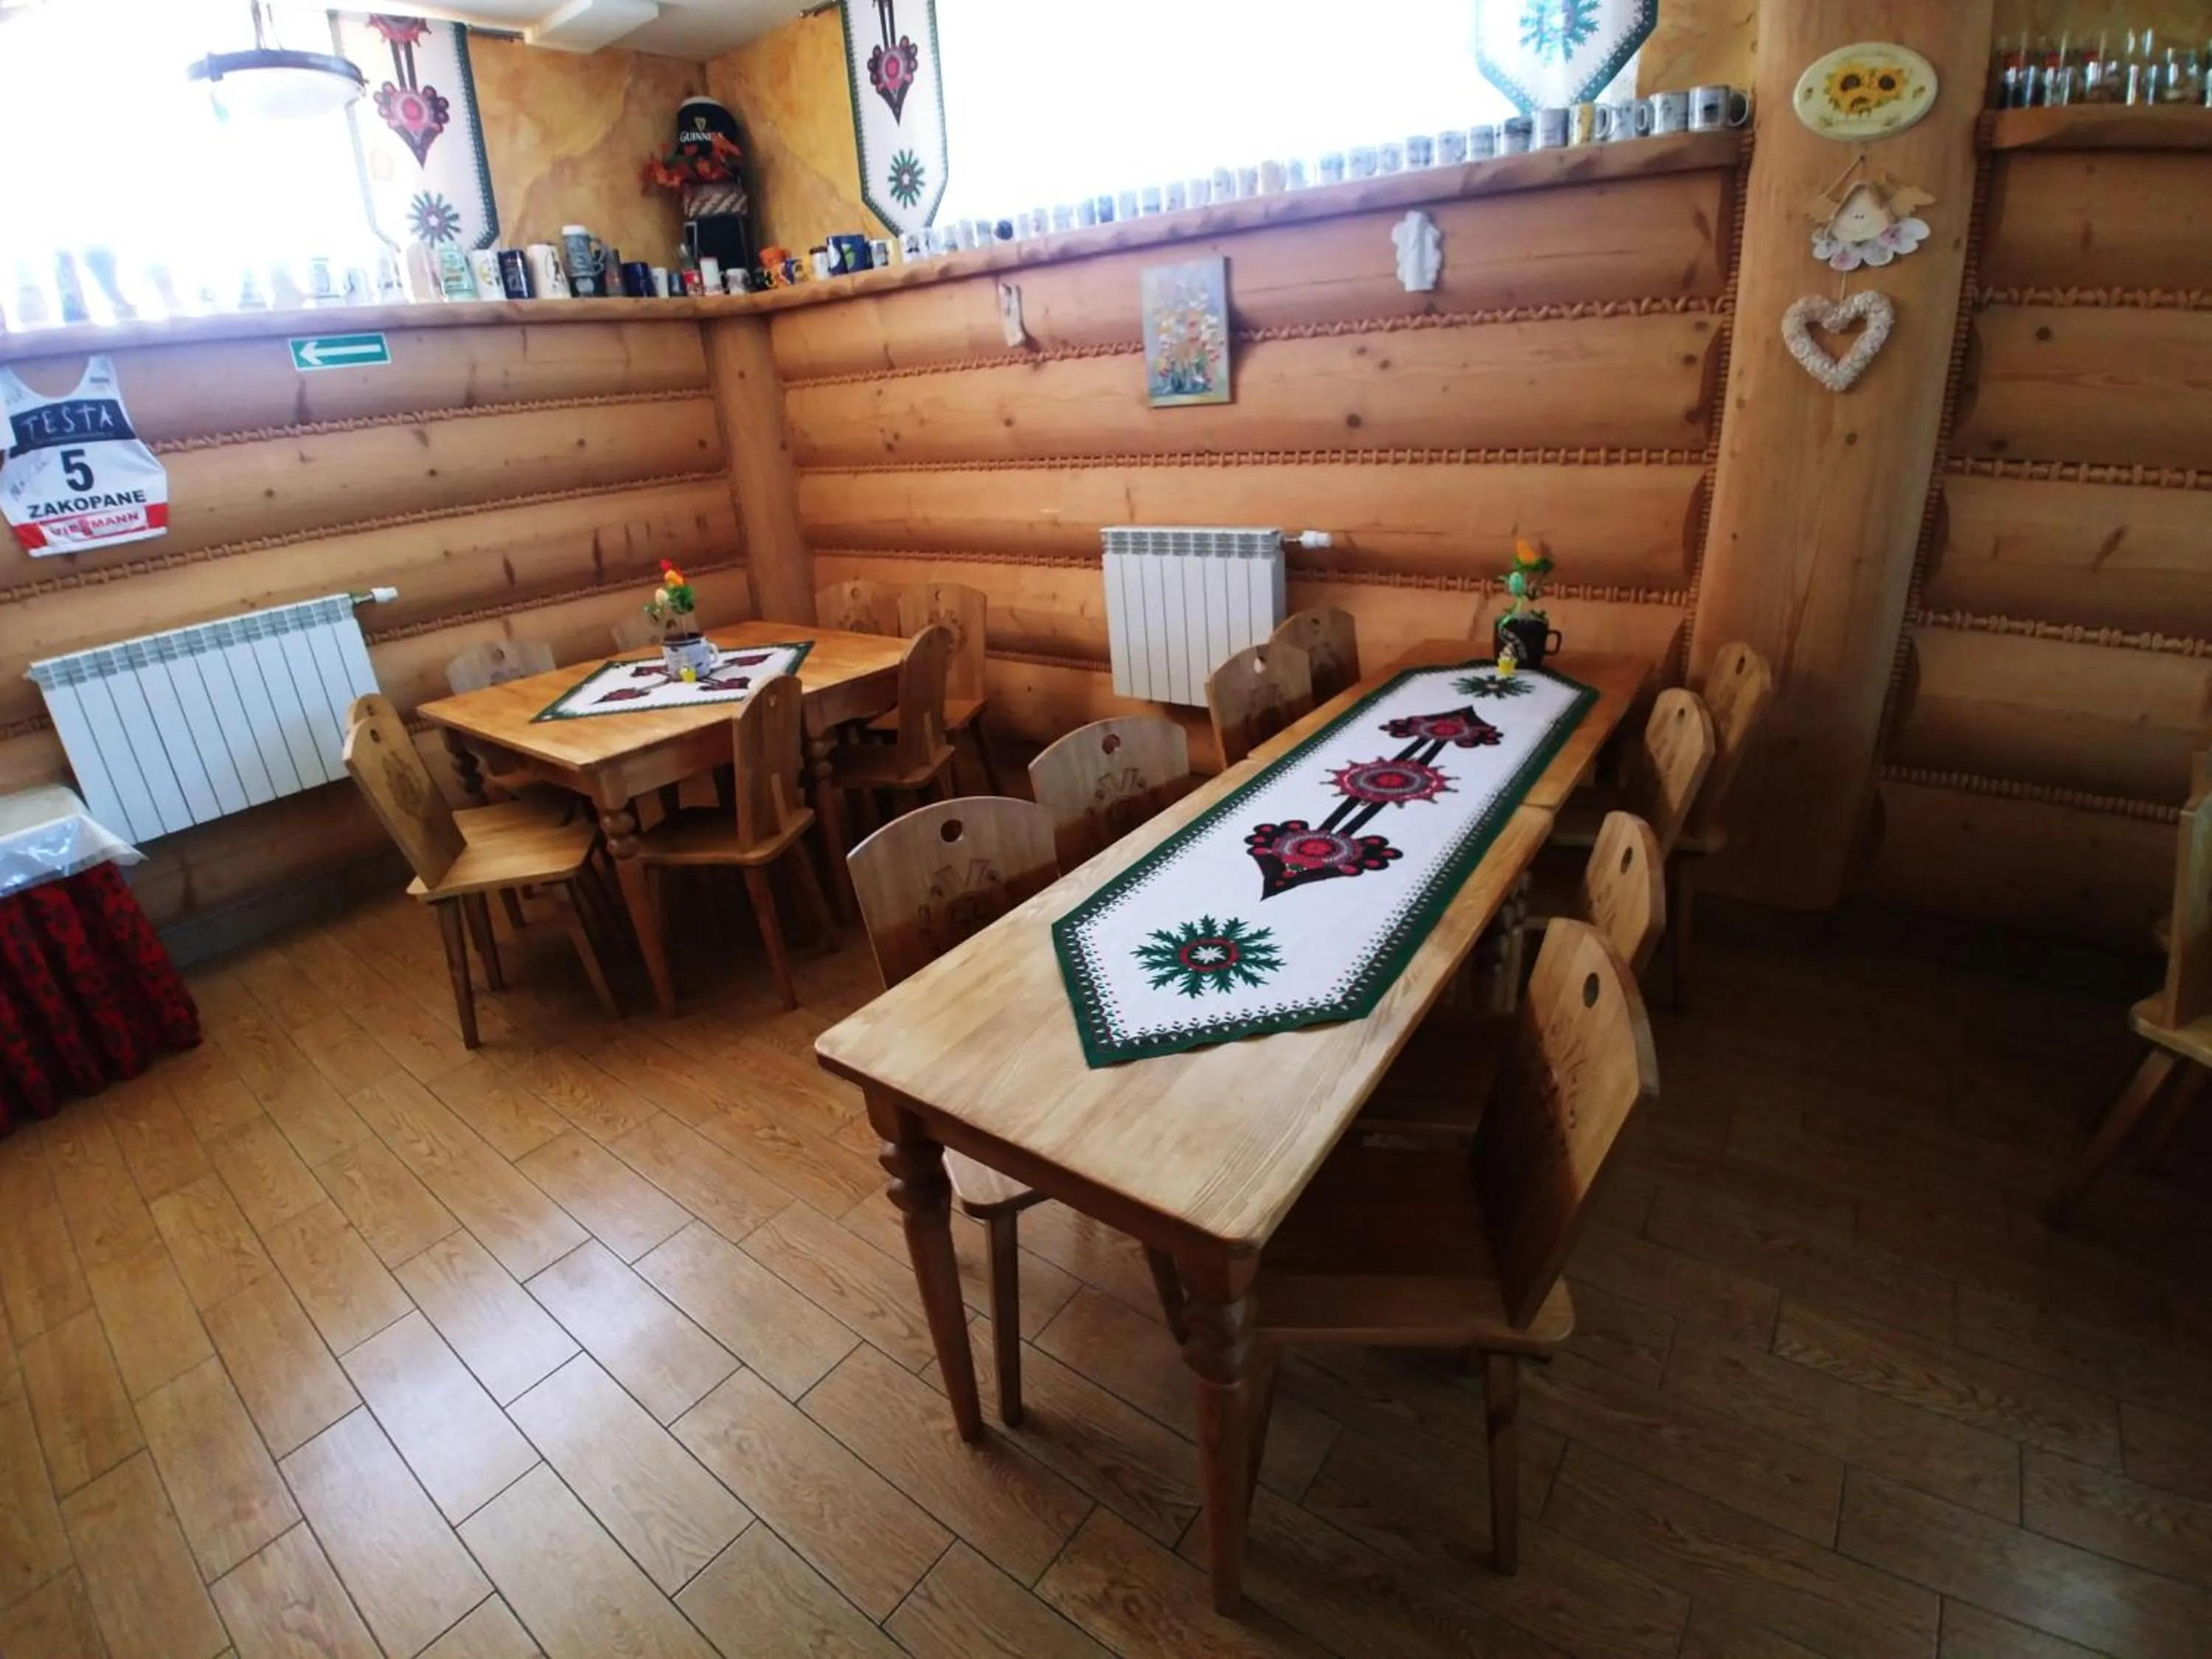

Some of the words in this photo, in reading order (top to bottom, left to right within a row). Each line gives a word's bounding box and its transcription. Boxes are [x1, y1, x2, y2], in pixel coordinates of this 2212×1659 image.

[679, 131, 723, 143] GUINN
[21, 403, 114, 441] TESTA
[60, 448, 95, 492] 5
[28, 490, 147, 518] ZAKOPANE
[49, 512, 139, 537] VIMANN
